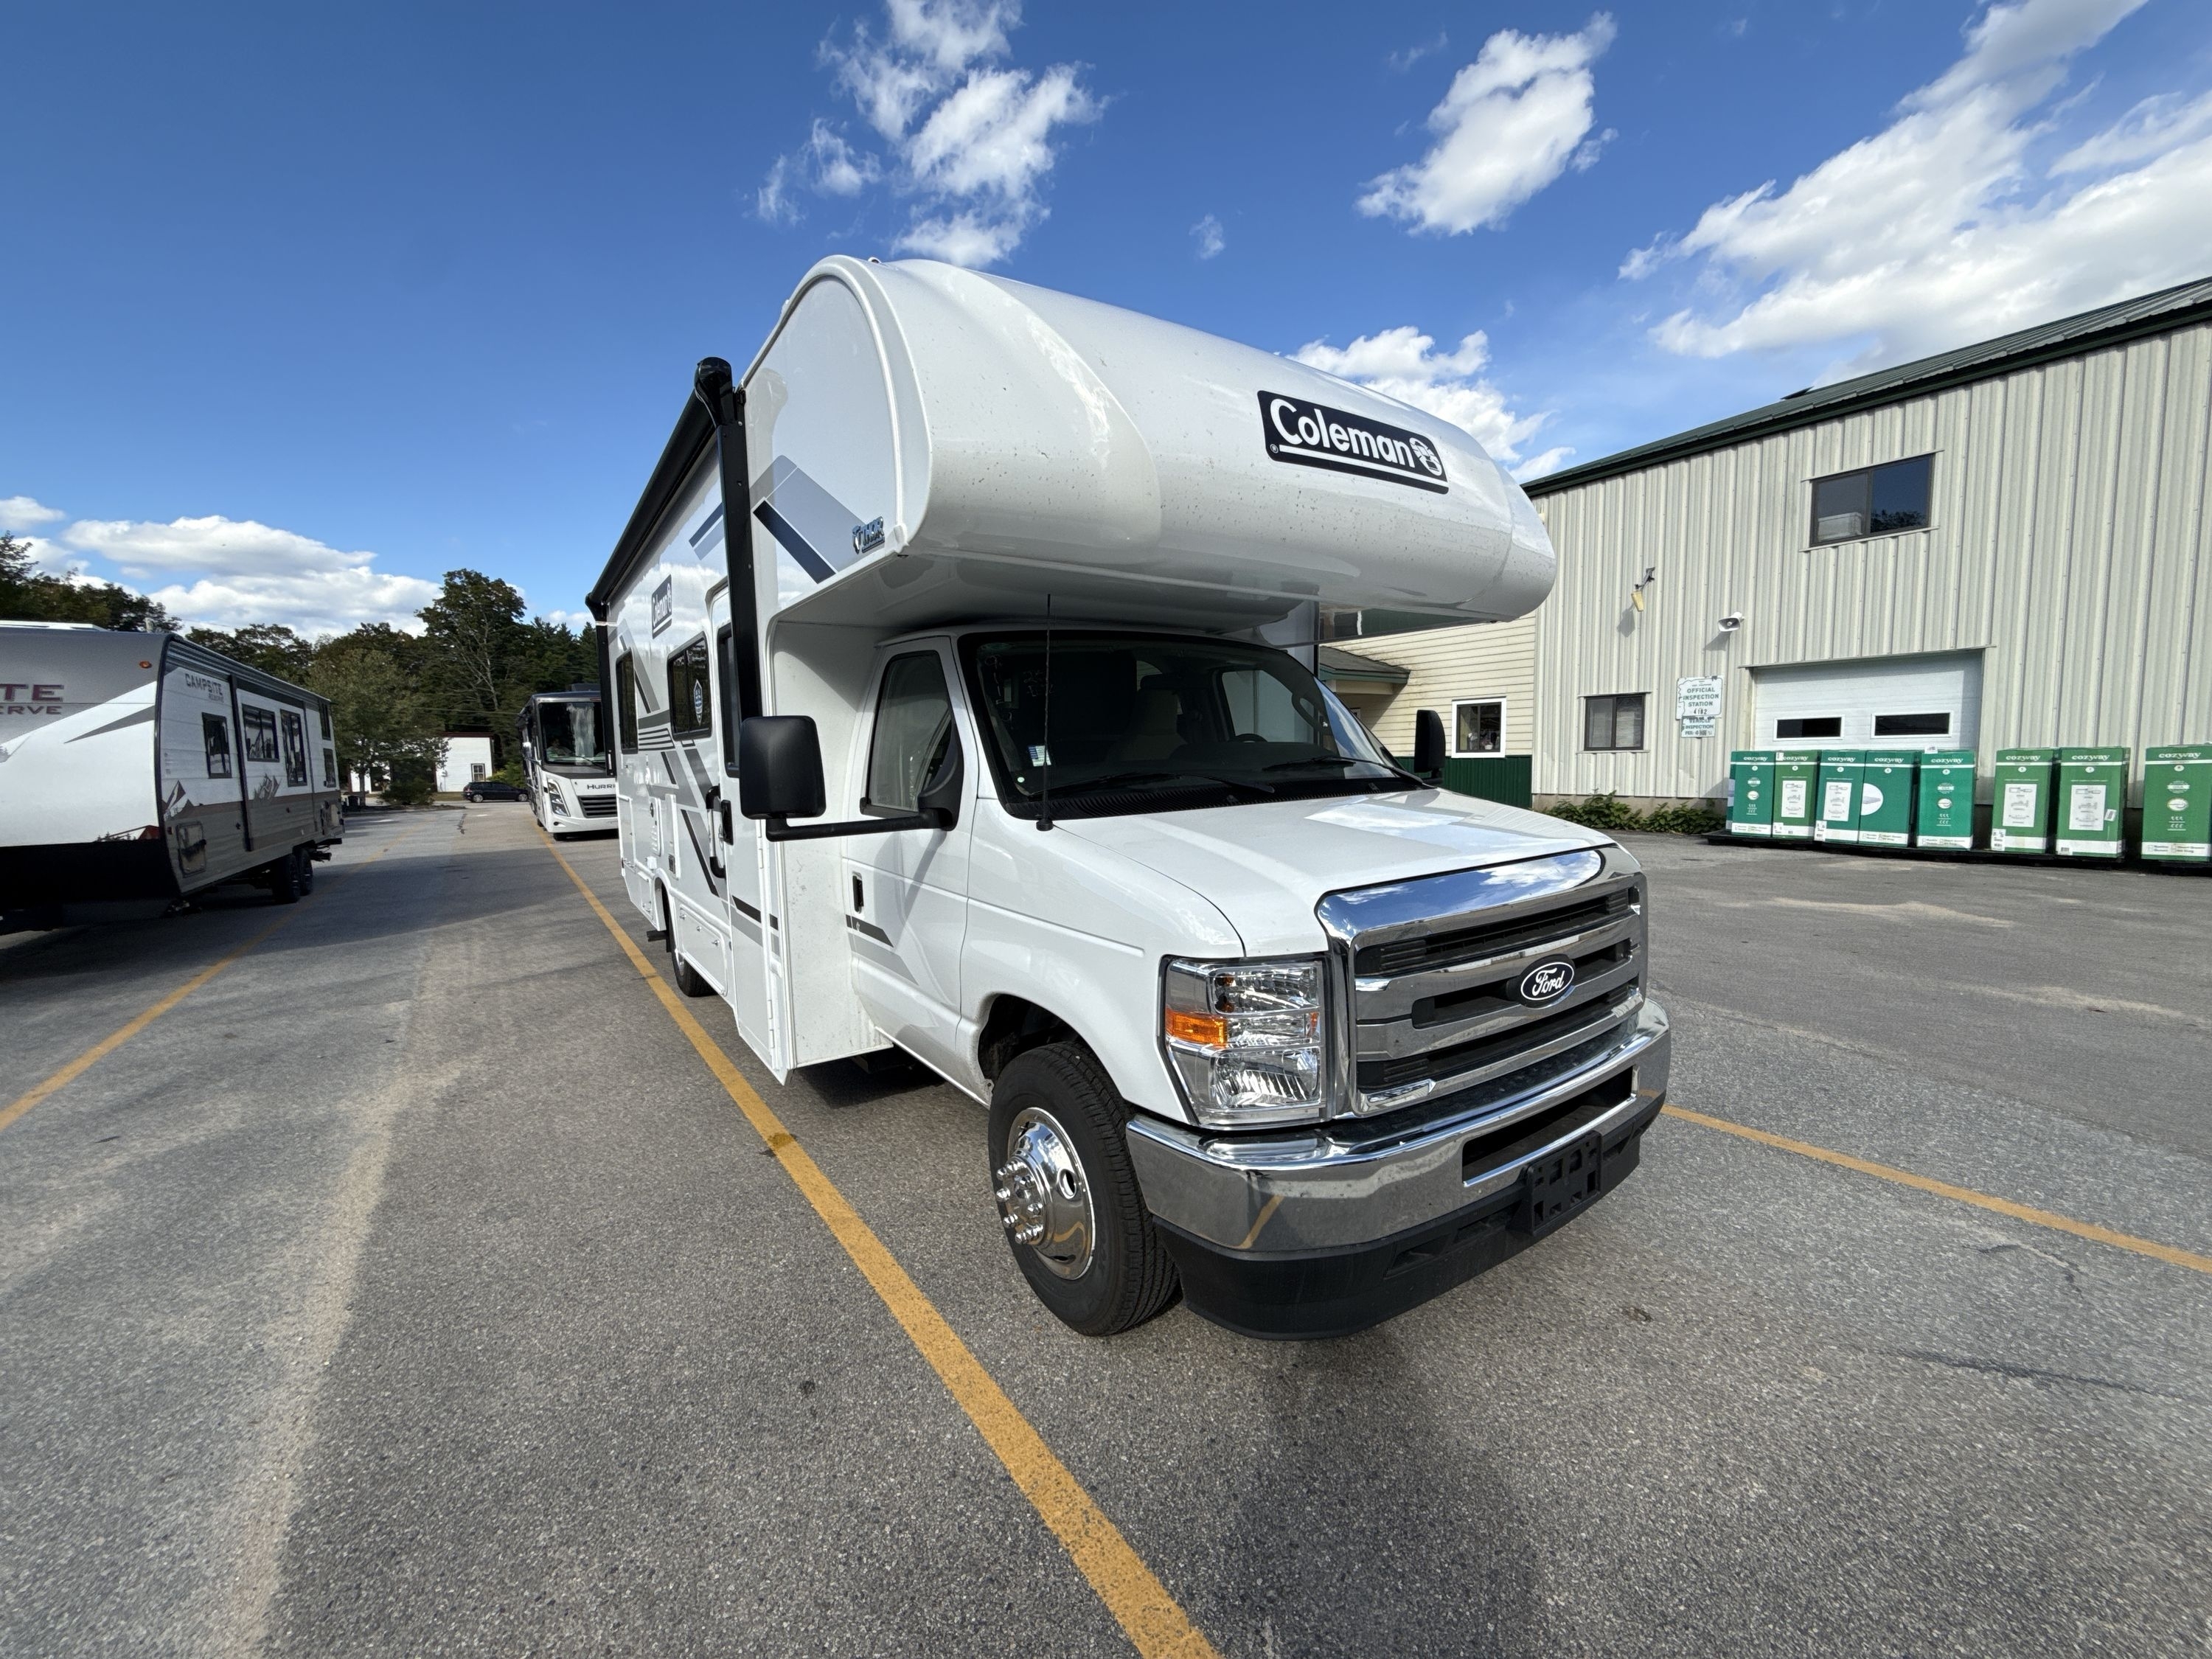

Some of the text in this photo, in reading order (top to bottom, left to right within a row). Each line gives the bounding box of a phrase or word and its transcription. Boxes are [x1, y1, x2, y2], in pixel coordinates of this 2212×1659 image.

[1270, 398, 1416, 468] Coleman
[652, 594, 668, 627] Coleman
[185, 673, 223, 695] CAMPSITE
[0, 706, 63, 714] RVE
[1531, 967, 1565, 996] Ford
